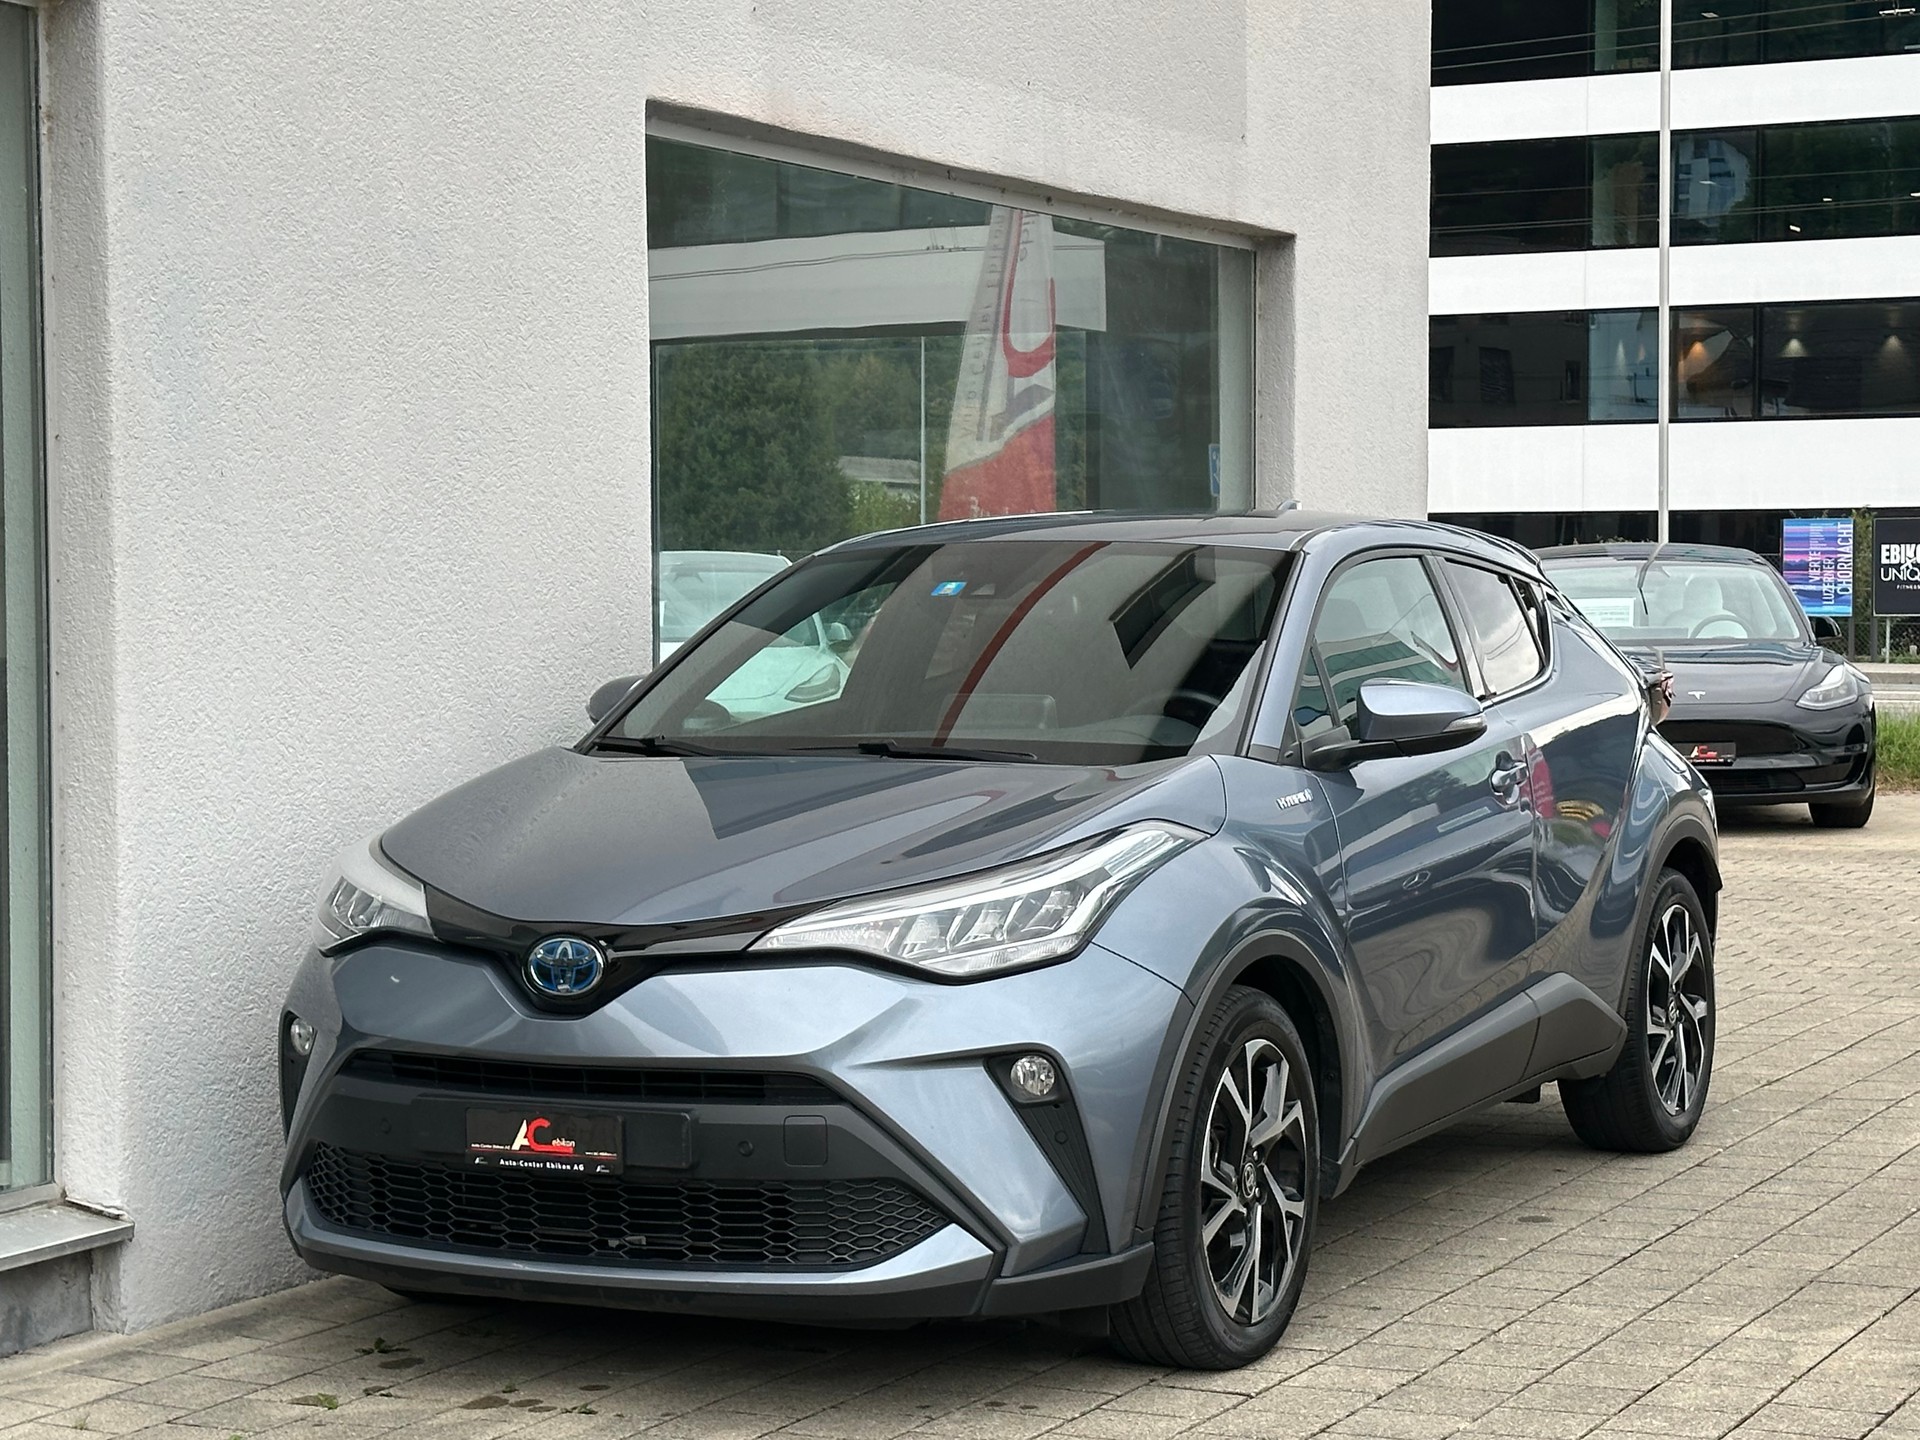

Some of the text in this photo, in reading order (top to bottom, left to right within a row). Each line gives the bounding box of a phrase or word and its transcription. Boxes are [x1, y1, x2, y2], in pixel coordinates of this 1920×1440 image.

[1808, 550, 1821, 583] VIERTE
[1836, 522, 1853, 595] CHORNACHT
[1880, 566, 1920, 582] UNIQ
[1822, 558, 1835, 605] LUZERNER
[546, 1161, 571, 1170] Ebikon
[573, 1163, 584, 1172] AG
